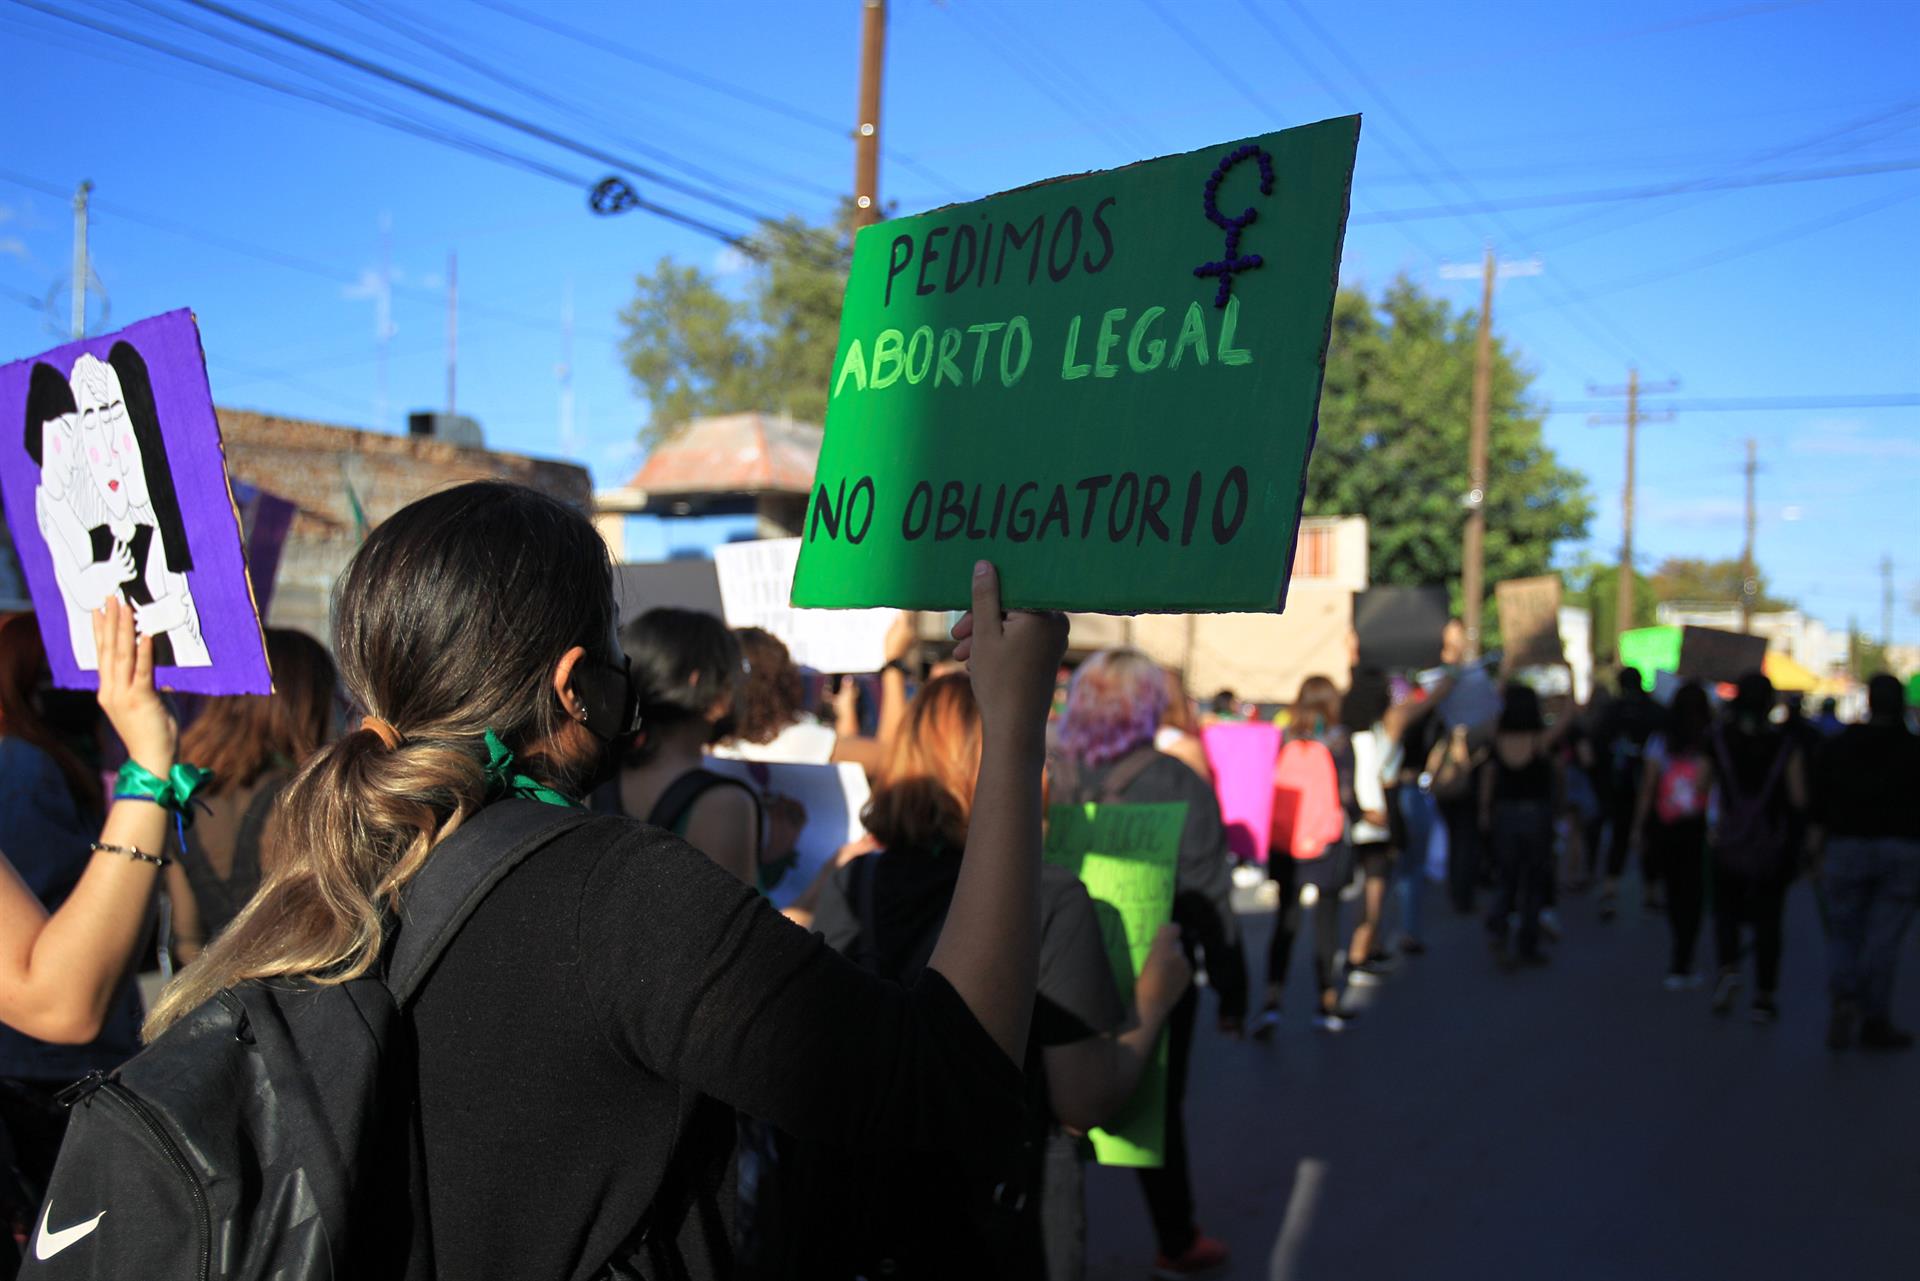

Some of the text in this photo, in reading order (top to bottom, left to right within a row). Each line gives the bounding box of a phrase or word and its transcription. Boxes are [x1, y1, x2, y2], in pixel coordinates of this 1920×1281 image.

[835, 295, 1253, 398] ABORTO LEGAL
[810, 464, 1249, 546] NO OBLIGATORIO
